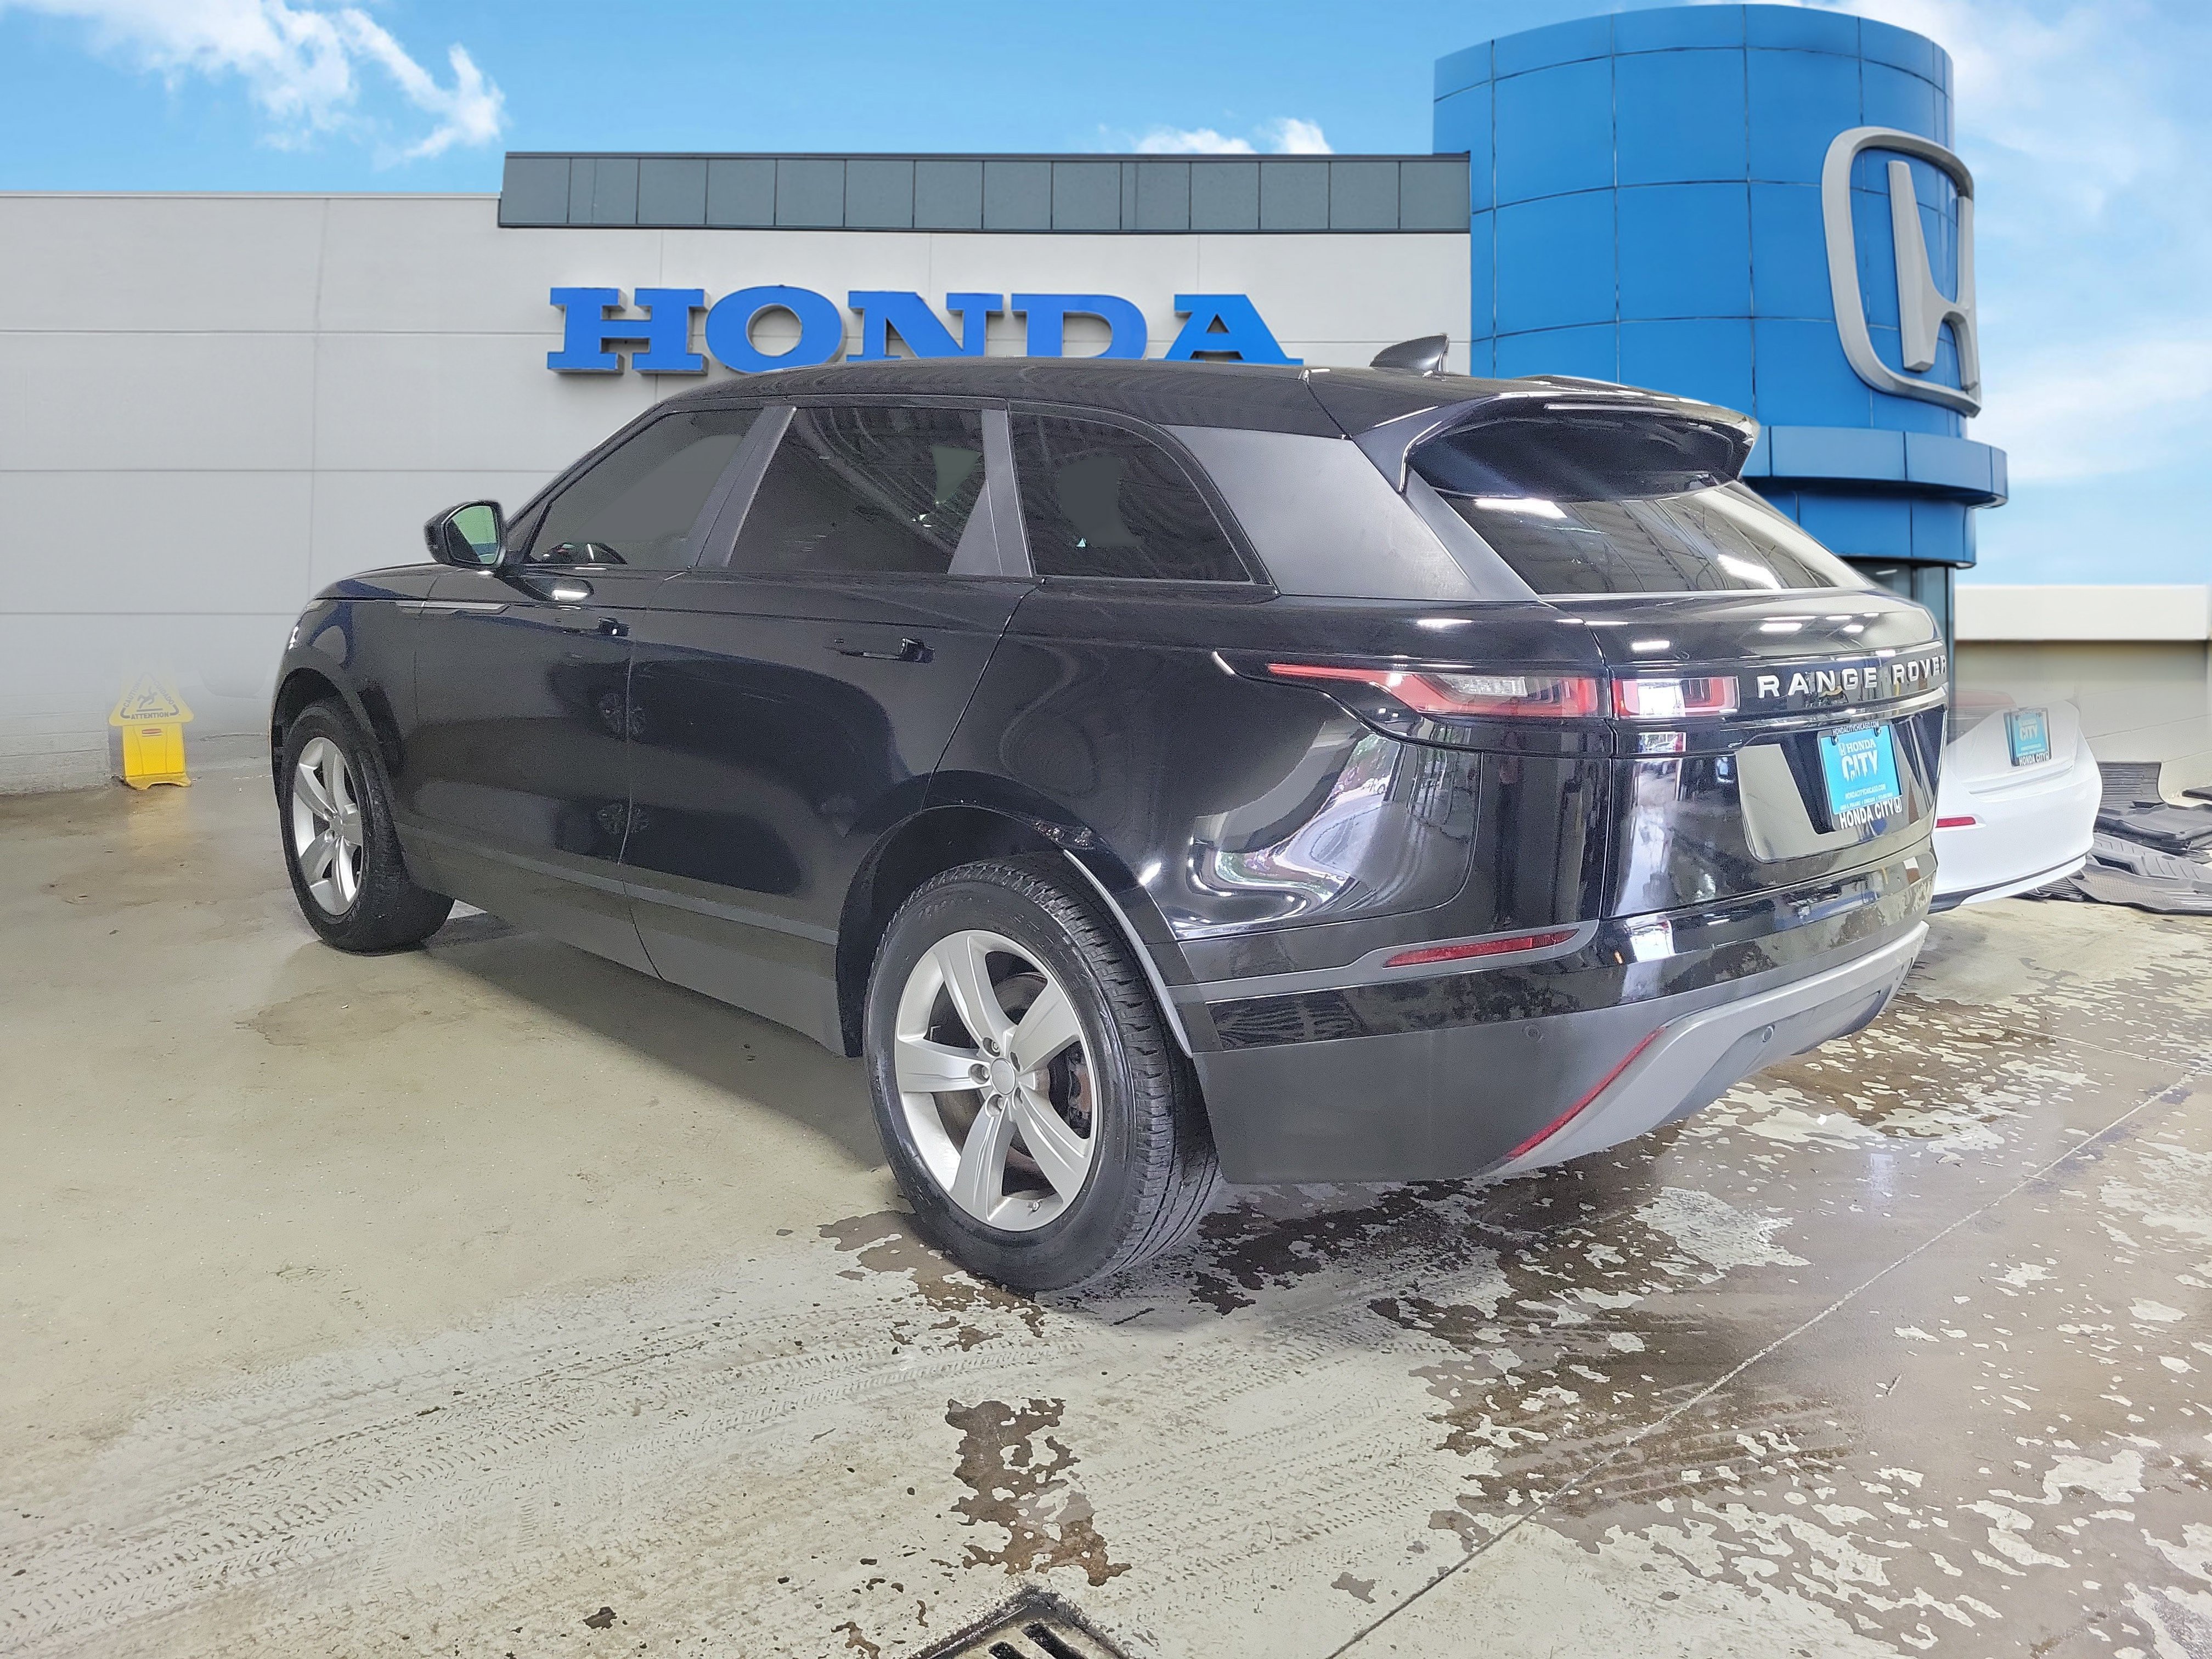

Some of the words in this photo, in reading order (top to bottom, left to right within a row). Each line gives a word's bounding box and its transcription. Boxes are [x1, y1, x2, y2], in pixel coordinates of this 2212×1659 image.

[547, 285, 1304, 375] HONDA
[1757, 667, 1878, 698] RANGE
[1891, 654, 1947, 685] ROVER
[123, 681, 141, 708] CAUTION
[153, 680, 174, 706] CUIDADO
[131, 712, 170, 720] ATTENTION
[1846, 738, 1877, 753] HONDA
[2019, 724, 2038, 742] CITY
[1841, 749, 1878, 782] CITY
[2019, 754, 2036, 766] HONDA
[2035, 752, 2046, 763] CITY
[1839, 805, 1874, 830] HONDA
[1874, 799, 1894, 819] CITY
